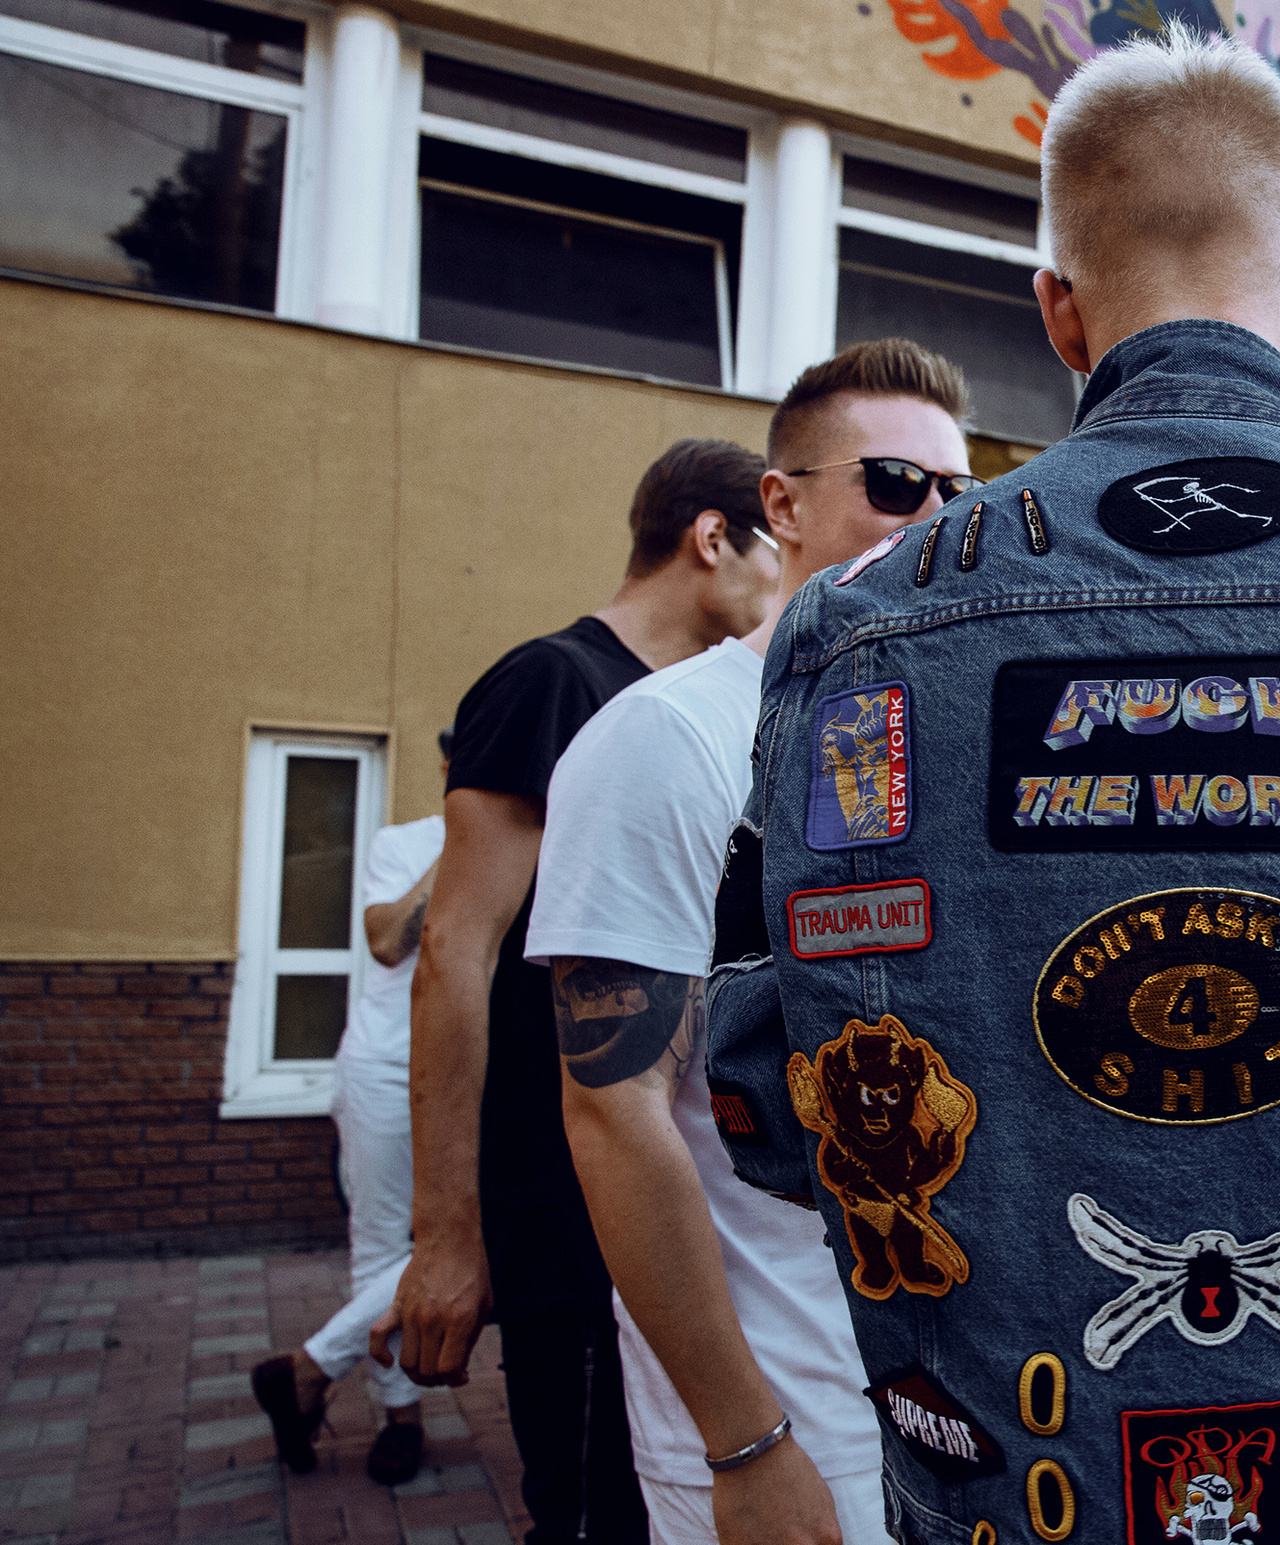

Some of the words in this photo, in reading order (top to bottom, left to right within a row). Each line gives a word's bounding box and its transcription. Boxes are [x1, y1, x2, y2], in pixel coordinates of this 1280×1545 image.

[964, 520, 979, 563] 2018
[1023, 507, 1044, 549] 2018
[889, 696, 904, 763] YORK
[891, 771, 906, 828] NEW
[1013, 774, 1139, 826] THE
[796, 905, 872, 938] TRAUMA
[877, 900, 922, 928] UNIT
[1052, 907, 1166, 1008] DON'T
[1182, 903, 1280, 948] ASK
[1163, 976, 1218, 1042] 4
[887, 1388, 980, 1463] SUPREME
